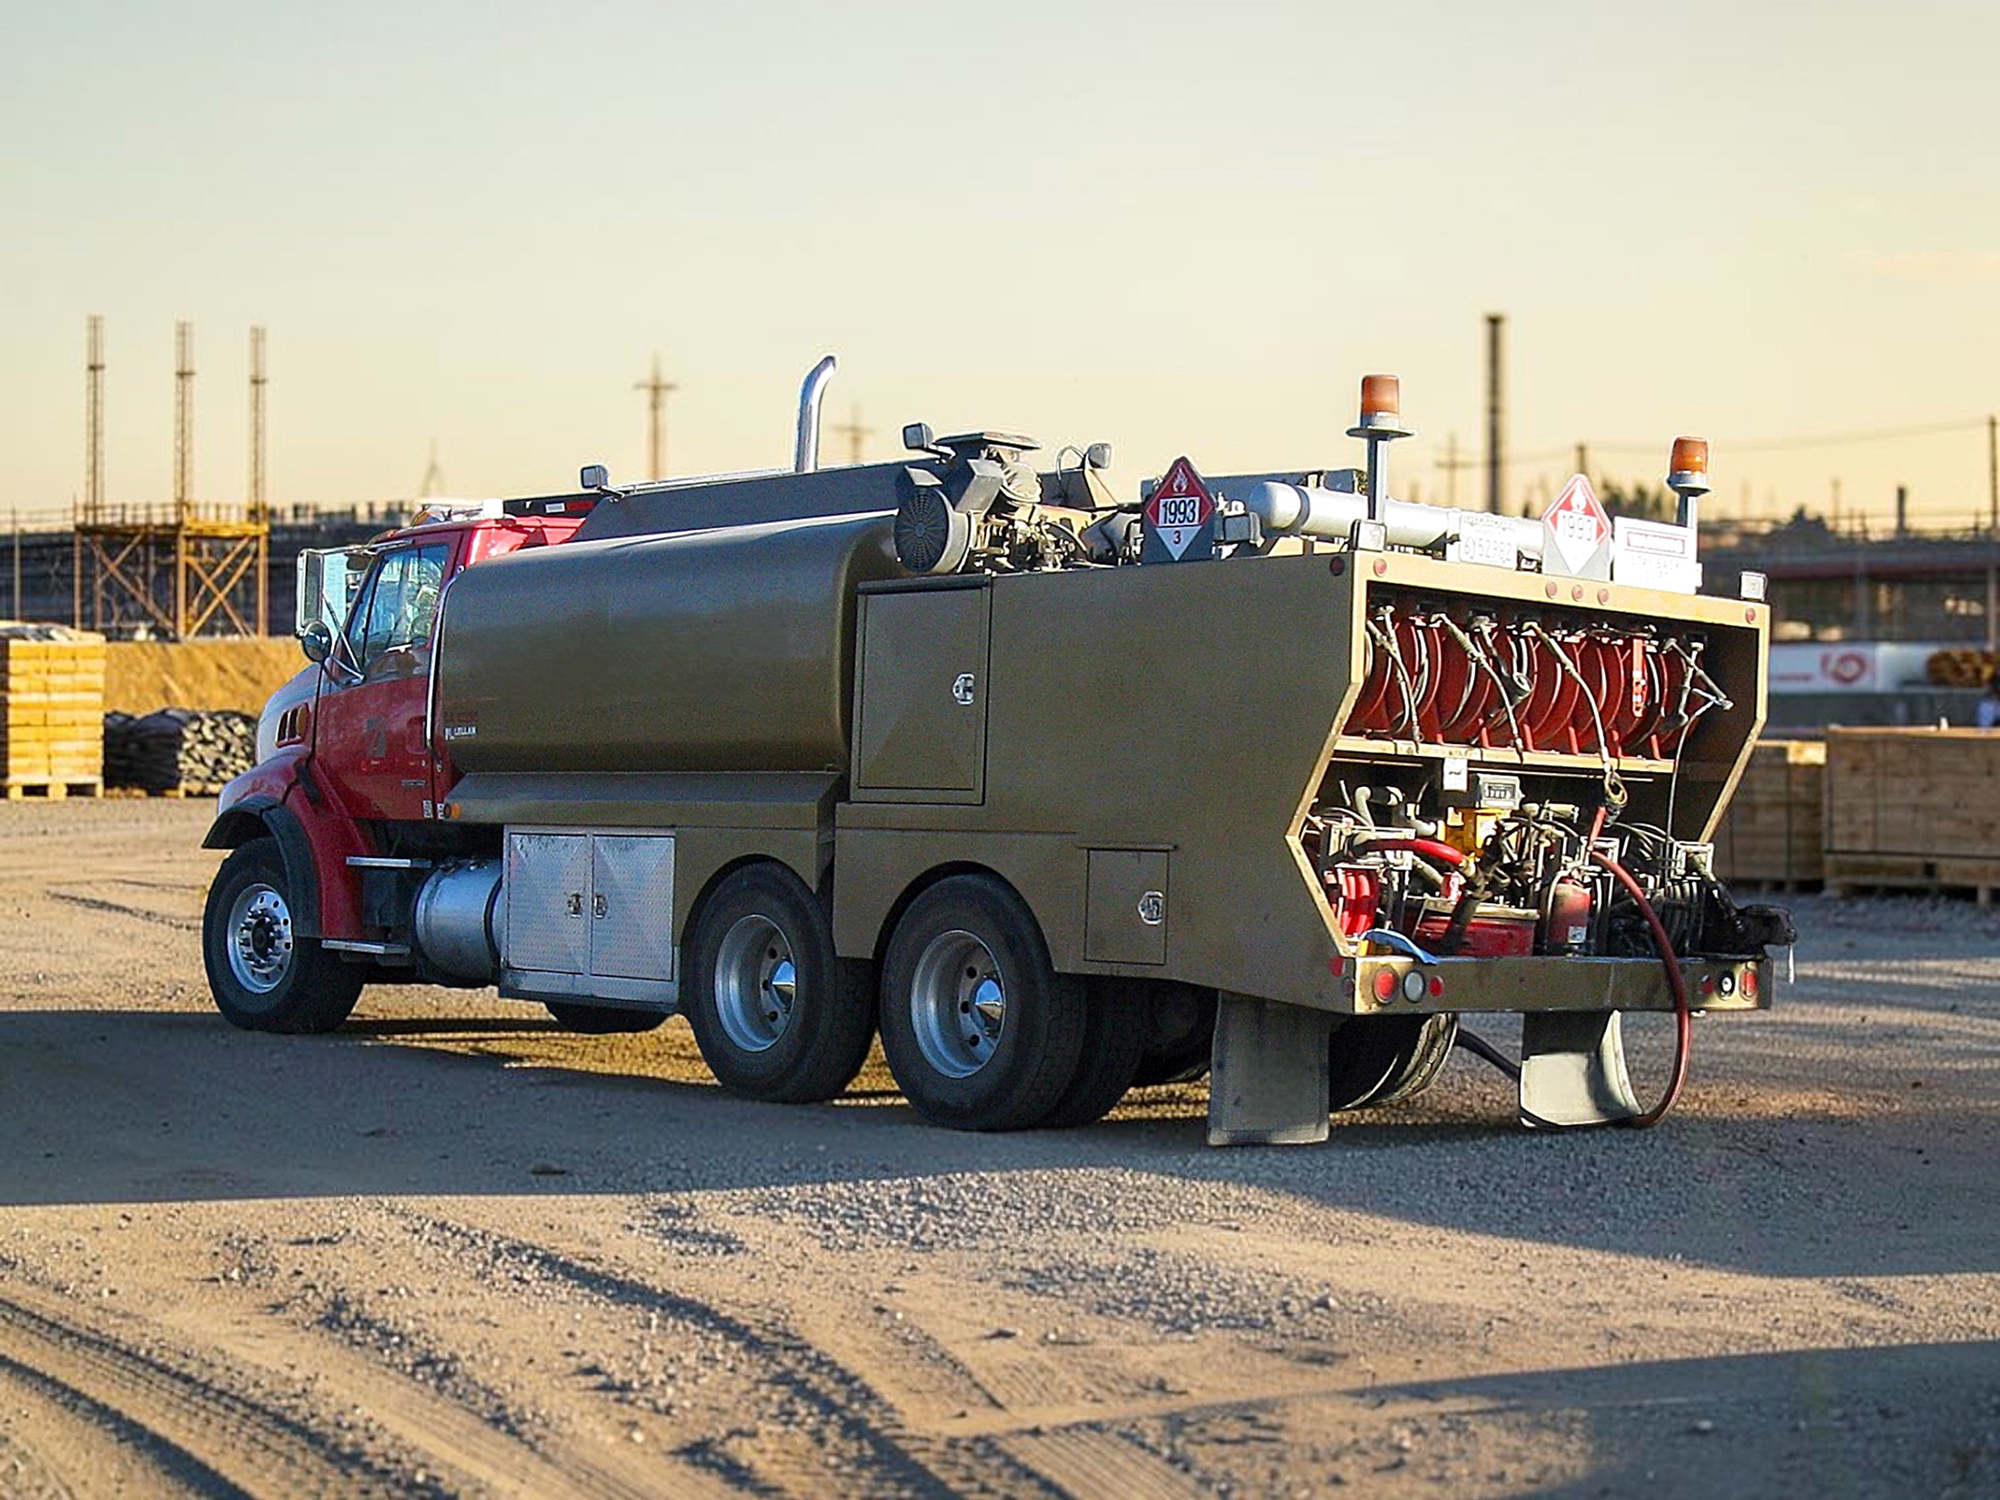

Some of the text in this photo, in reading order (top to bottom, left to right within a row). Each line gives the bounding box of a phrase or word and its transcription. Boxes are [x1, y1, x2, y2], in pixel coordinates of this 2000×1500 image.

[1162, 500, 1197, 524] 1993
[1172, 530, 1182, 545] 3
[1562, 514, 1593, 542] 1993
